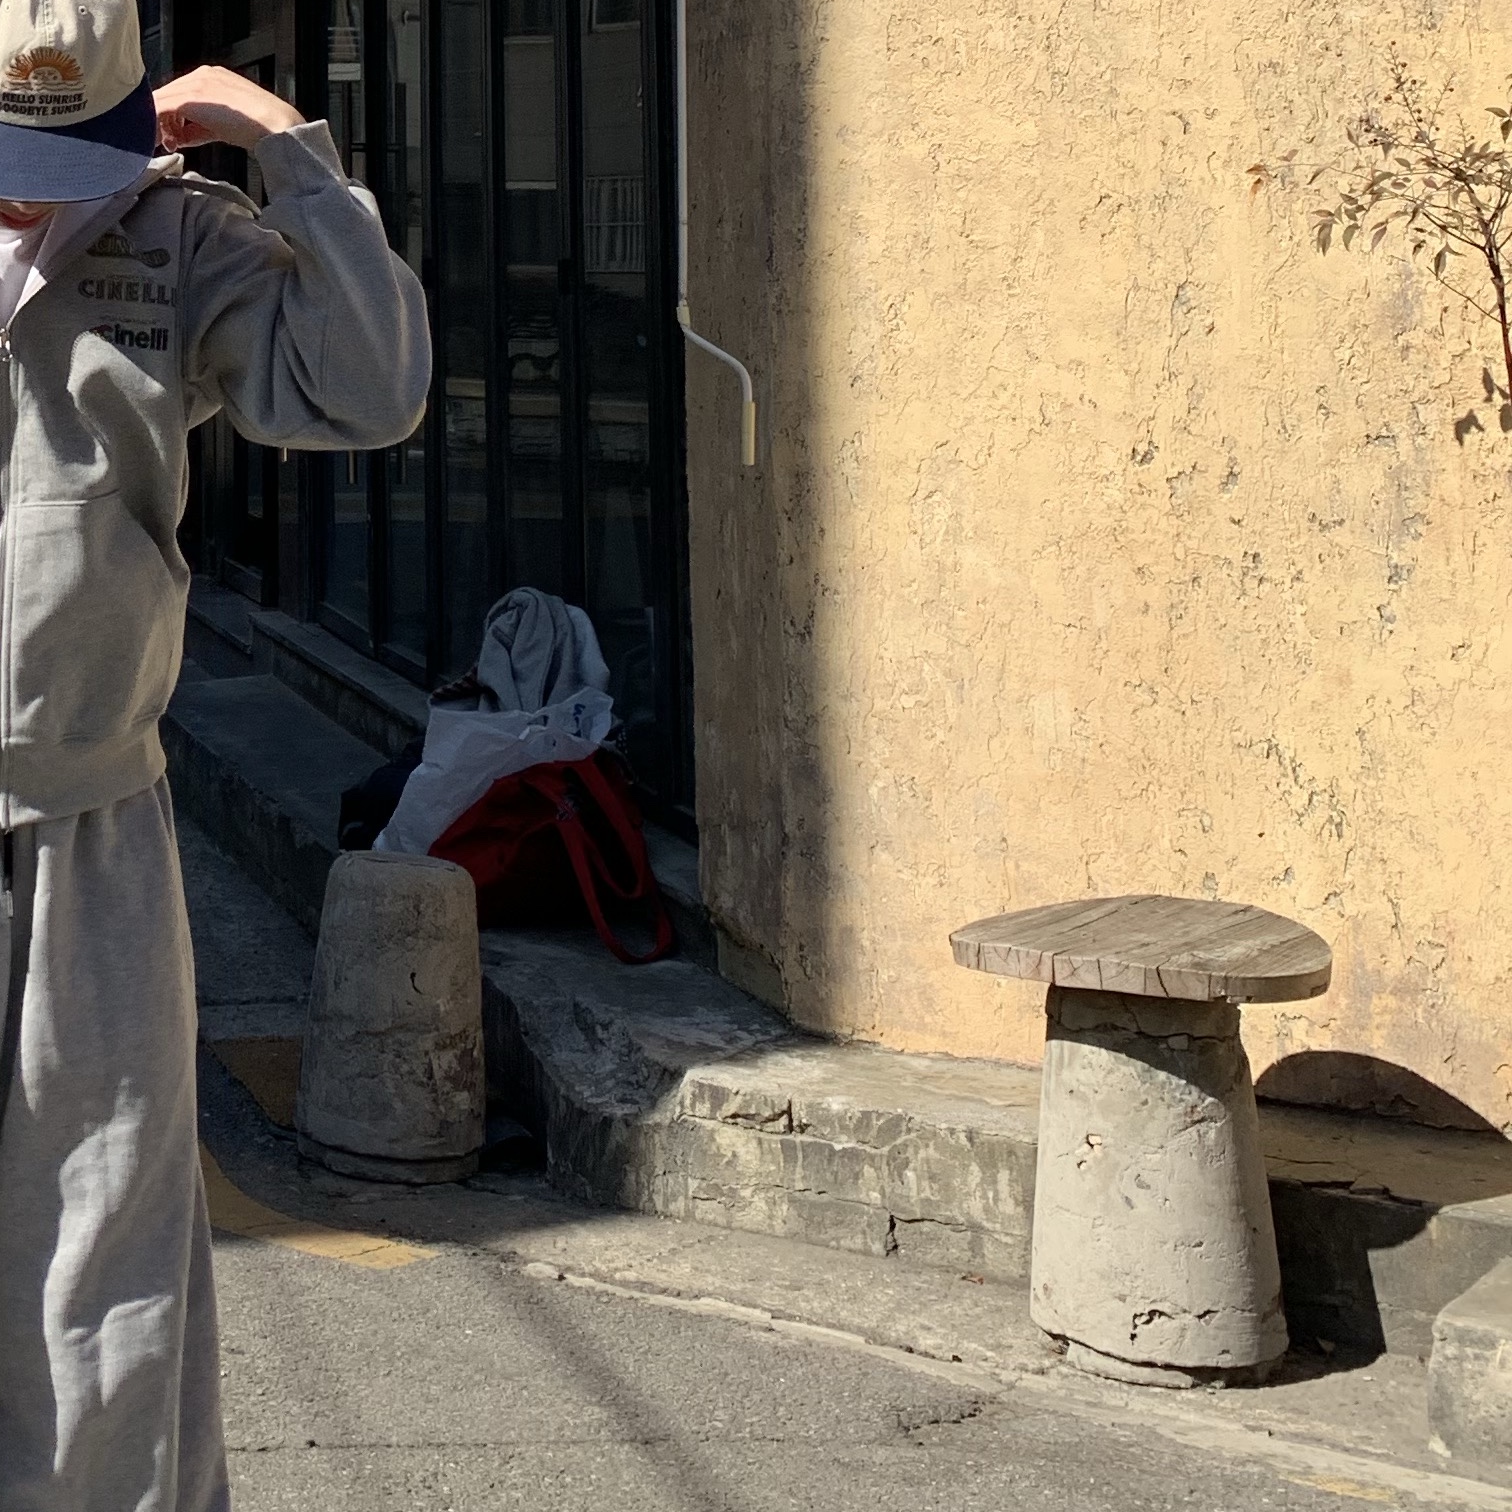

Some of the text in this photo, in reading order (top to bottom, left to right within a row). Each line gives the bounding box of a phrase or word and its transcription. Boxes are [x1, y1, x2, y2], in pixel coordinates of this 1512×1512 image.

[1, 92, 84, 105] HELLO SUNRISE
[50, 100, 88, 116] SUNSET
